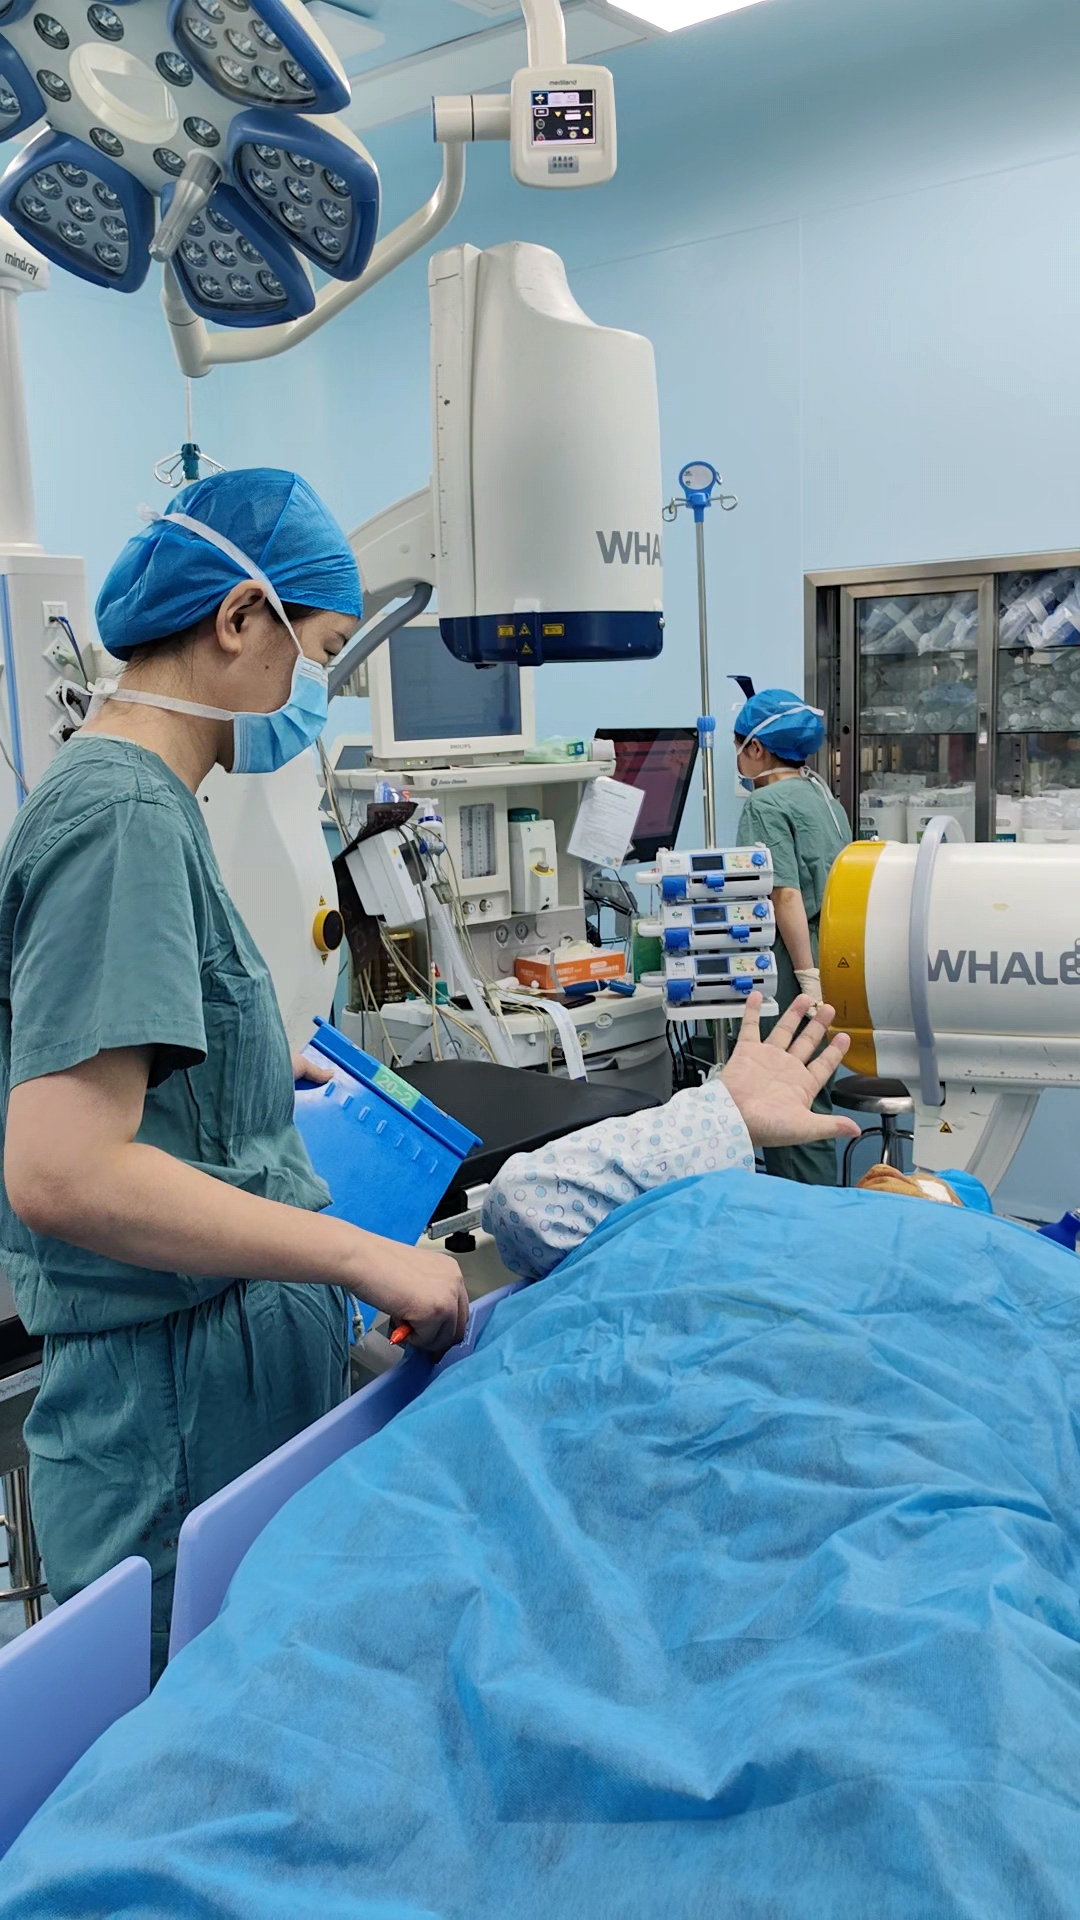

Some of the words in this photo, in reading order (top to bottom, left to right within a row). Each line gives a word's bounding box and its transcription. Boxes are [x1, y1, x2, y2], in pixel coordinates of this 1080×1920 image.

[5, 252, 39, 280] mindray
[596, 531, 662, 566] WHA
[376, 1074, 414, 1106] 20-2
